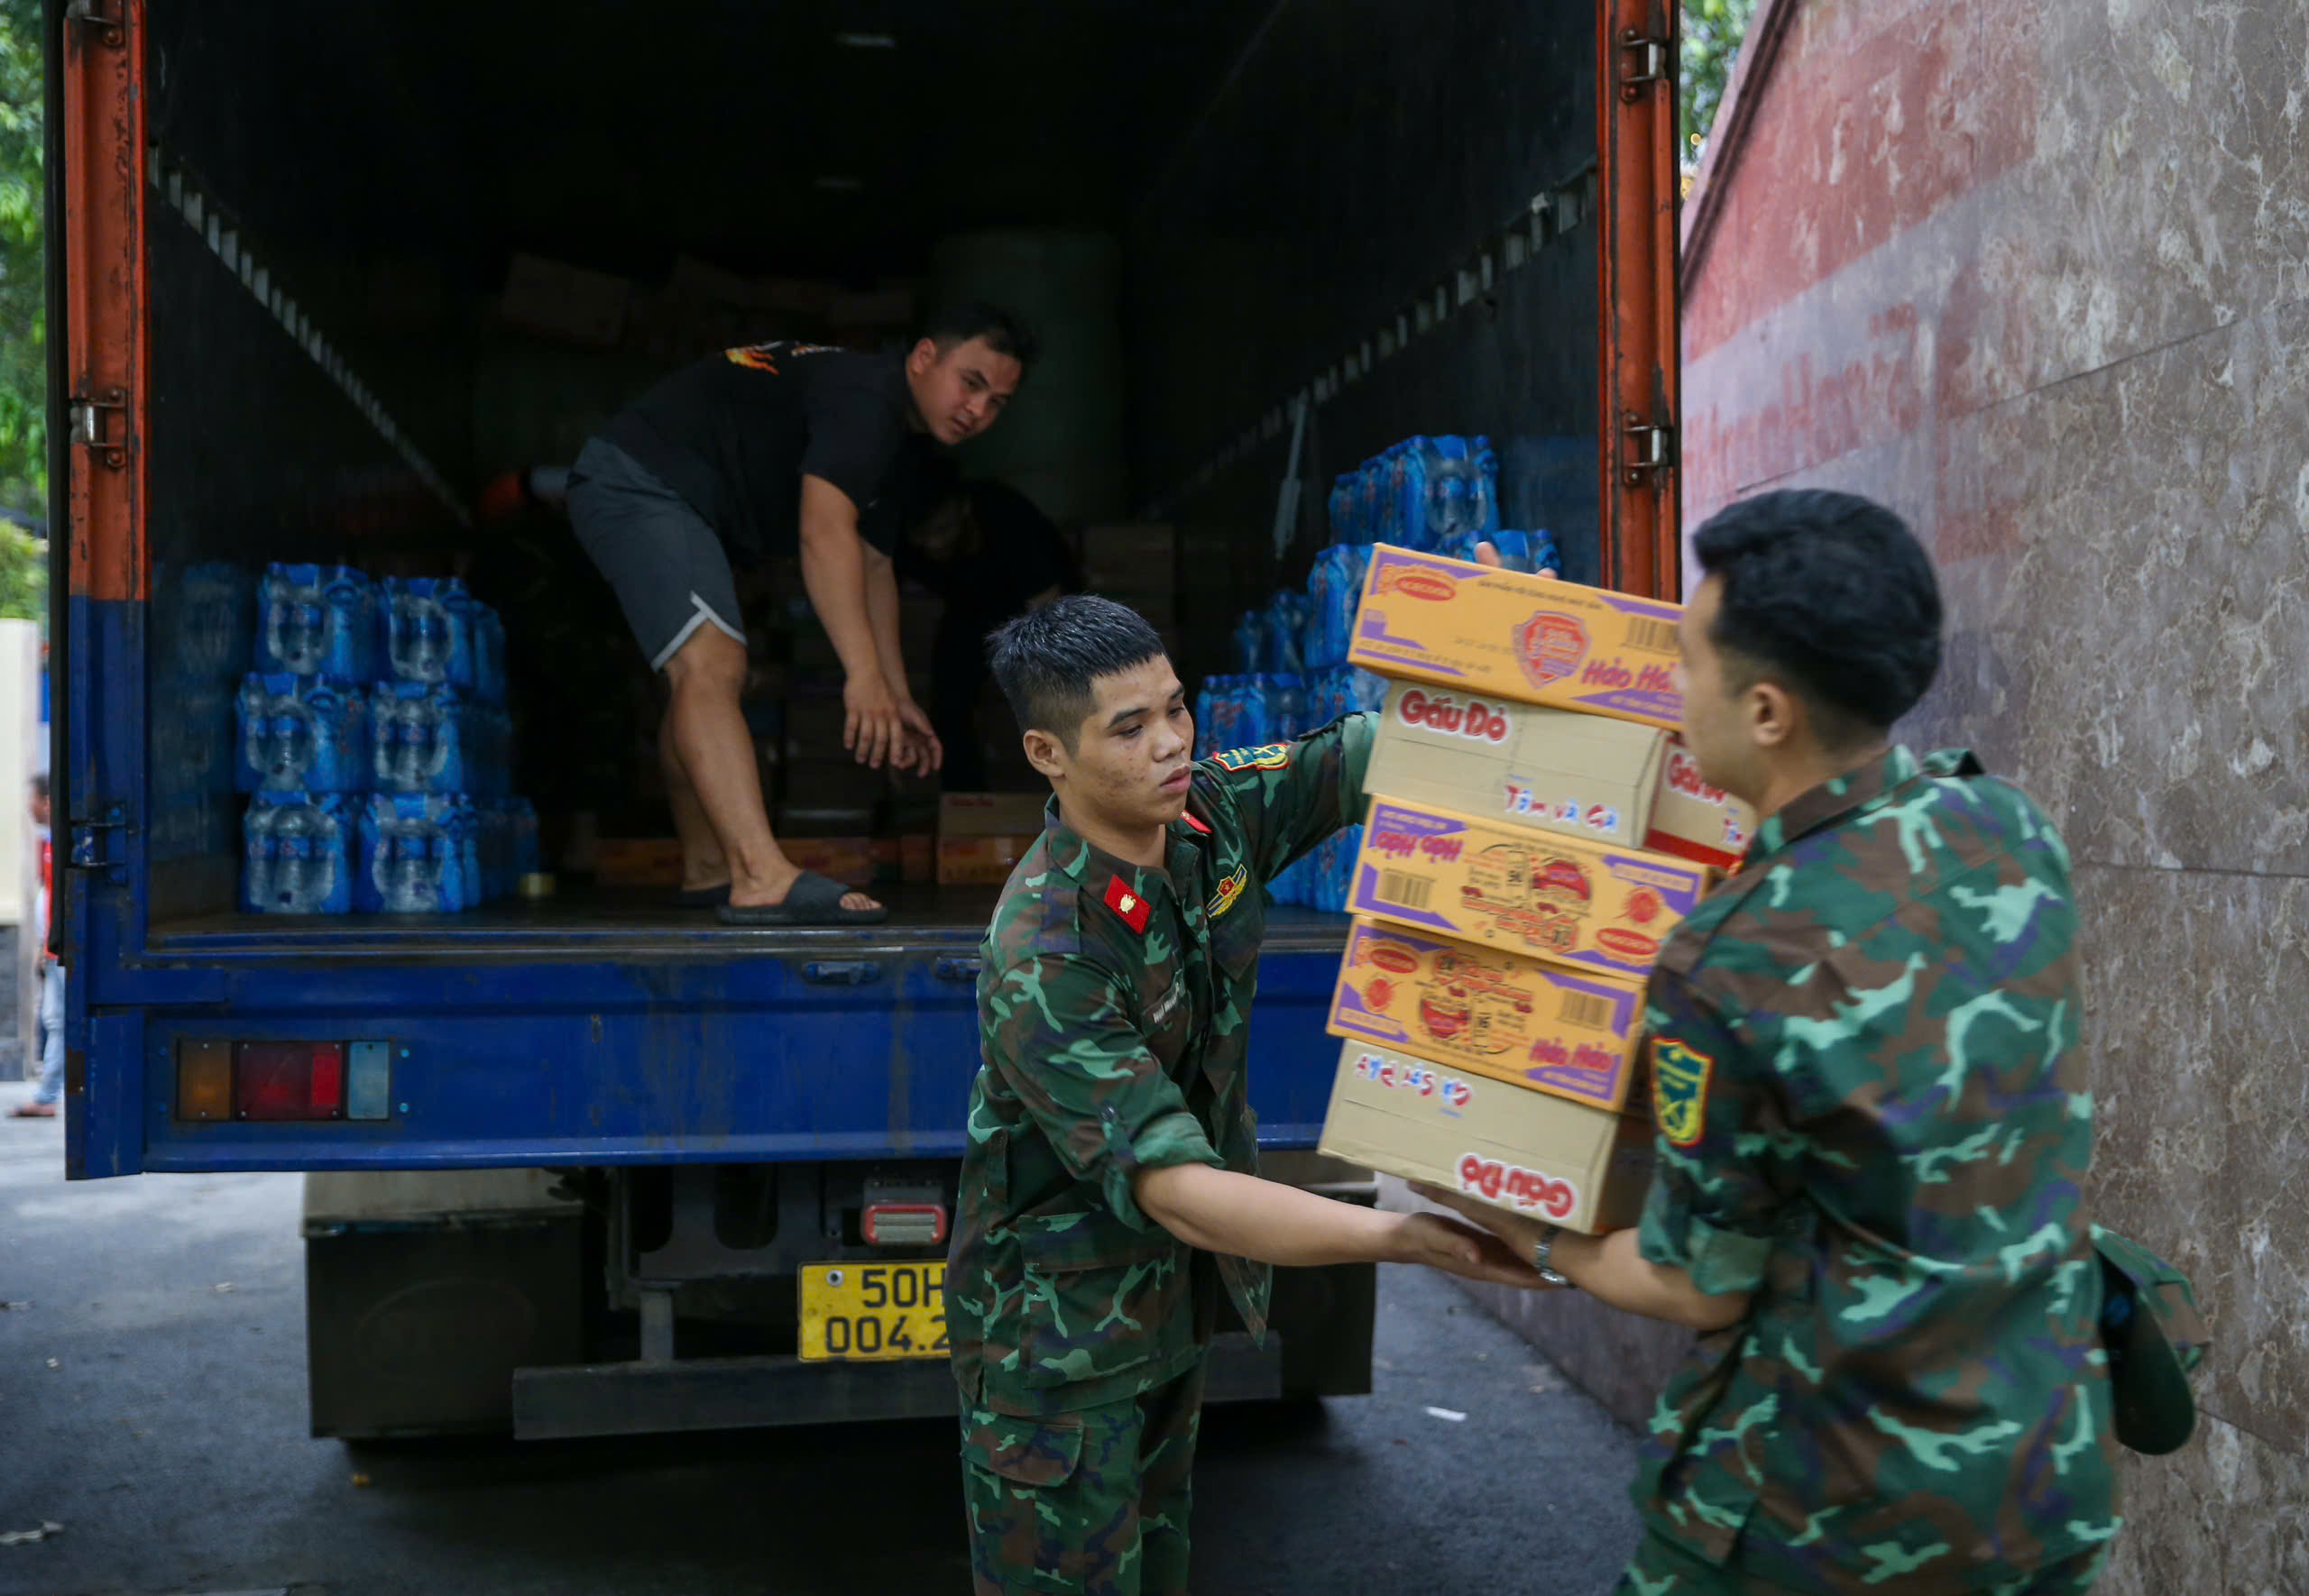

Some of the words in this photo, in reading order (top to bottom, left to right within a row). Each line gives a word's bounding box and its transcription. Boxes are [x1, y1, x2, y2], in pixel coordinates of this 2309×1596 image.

[1401, 689, 1463, 733] Gấu
[1464, 701, 1507, 742] Đỏ
[1460, 1154, 1504, 1199] Đỏ
[1506, 1167, 1575, 1219] Gấu
[860, 1268, 945, 1309] 50H
[825, 1315, 951, 1353] 004.2
